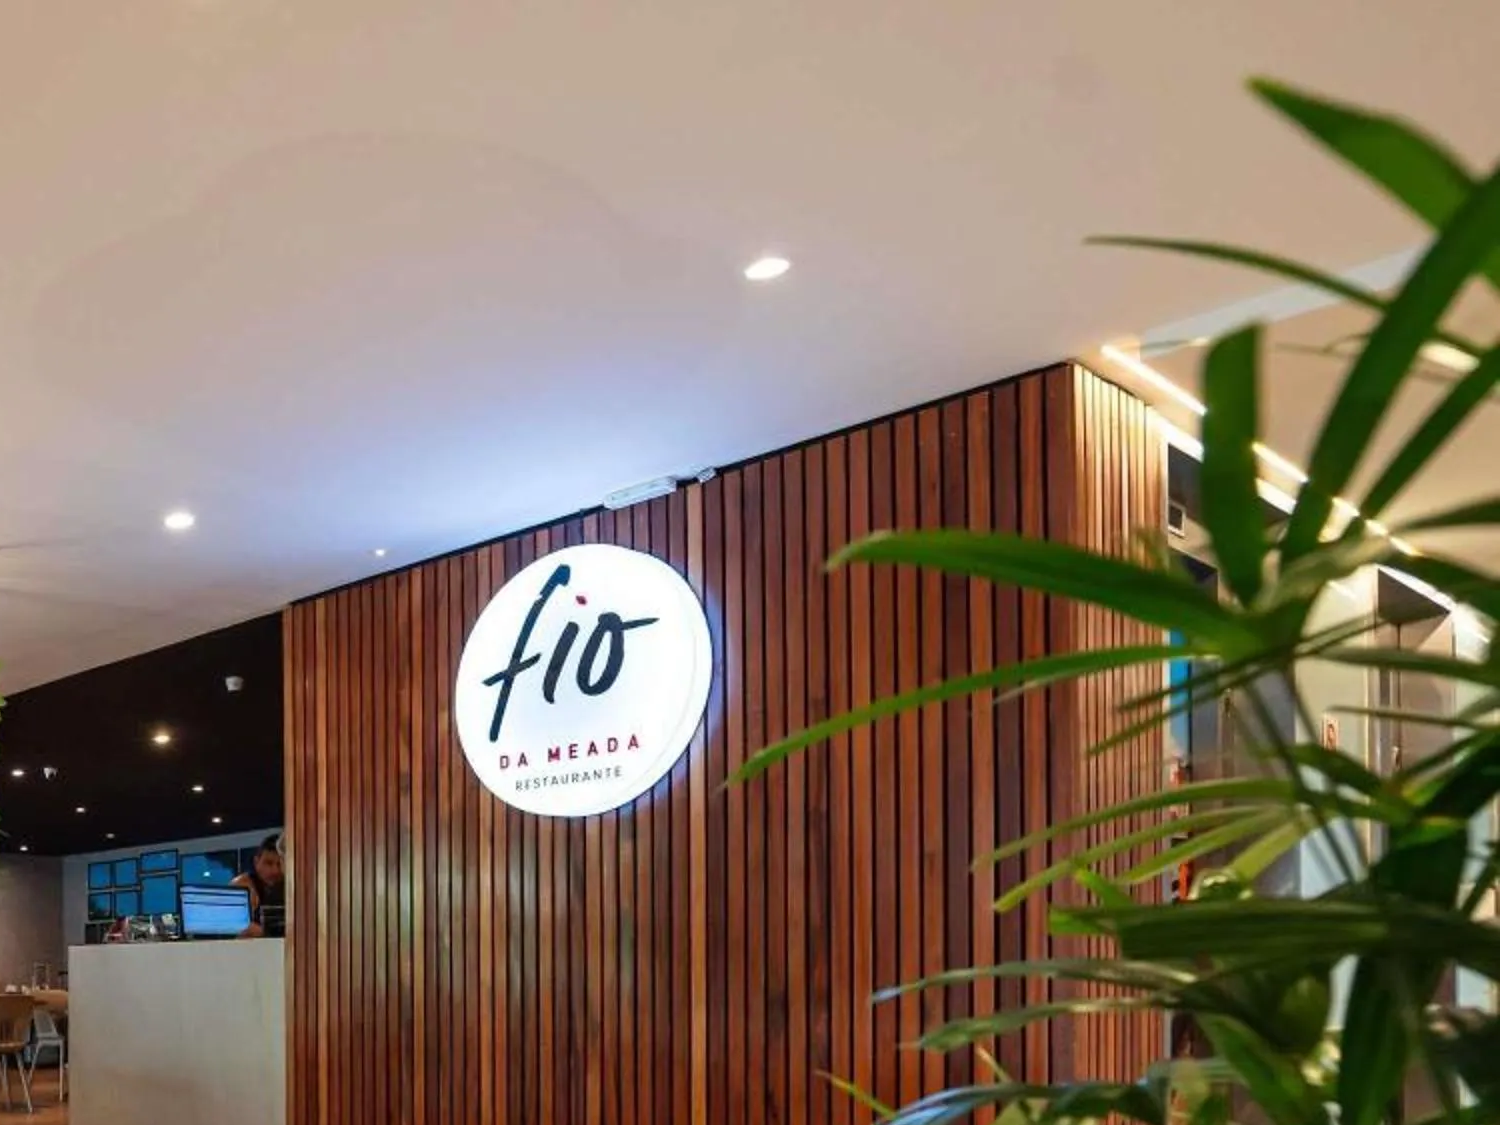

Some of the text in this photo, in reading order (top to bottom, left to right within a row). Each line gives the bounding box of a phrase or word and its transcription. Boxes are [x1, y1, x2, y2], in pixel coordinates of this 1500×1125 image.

[481, 563, 660, 743] fio
[499, 733, 640, 769] DA MEADA
[515, 765, 623, 791] RESTAURANTE
